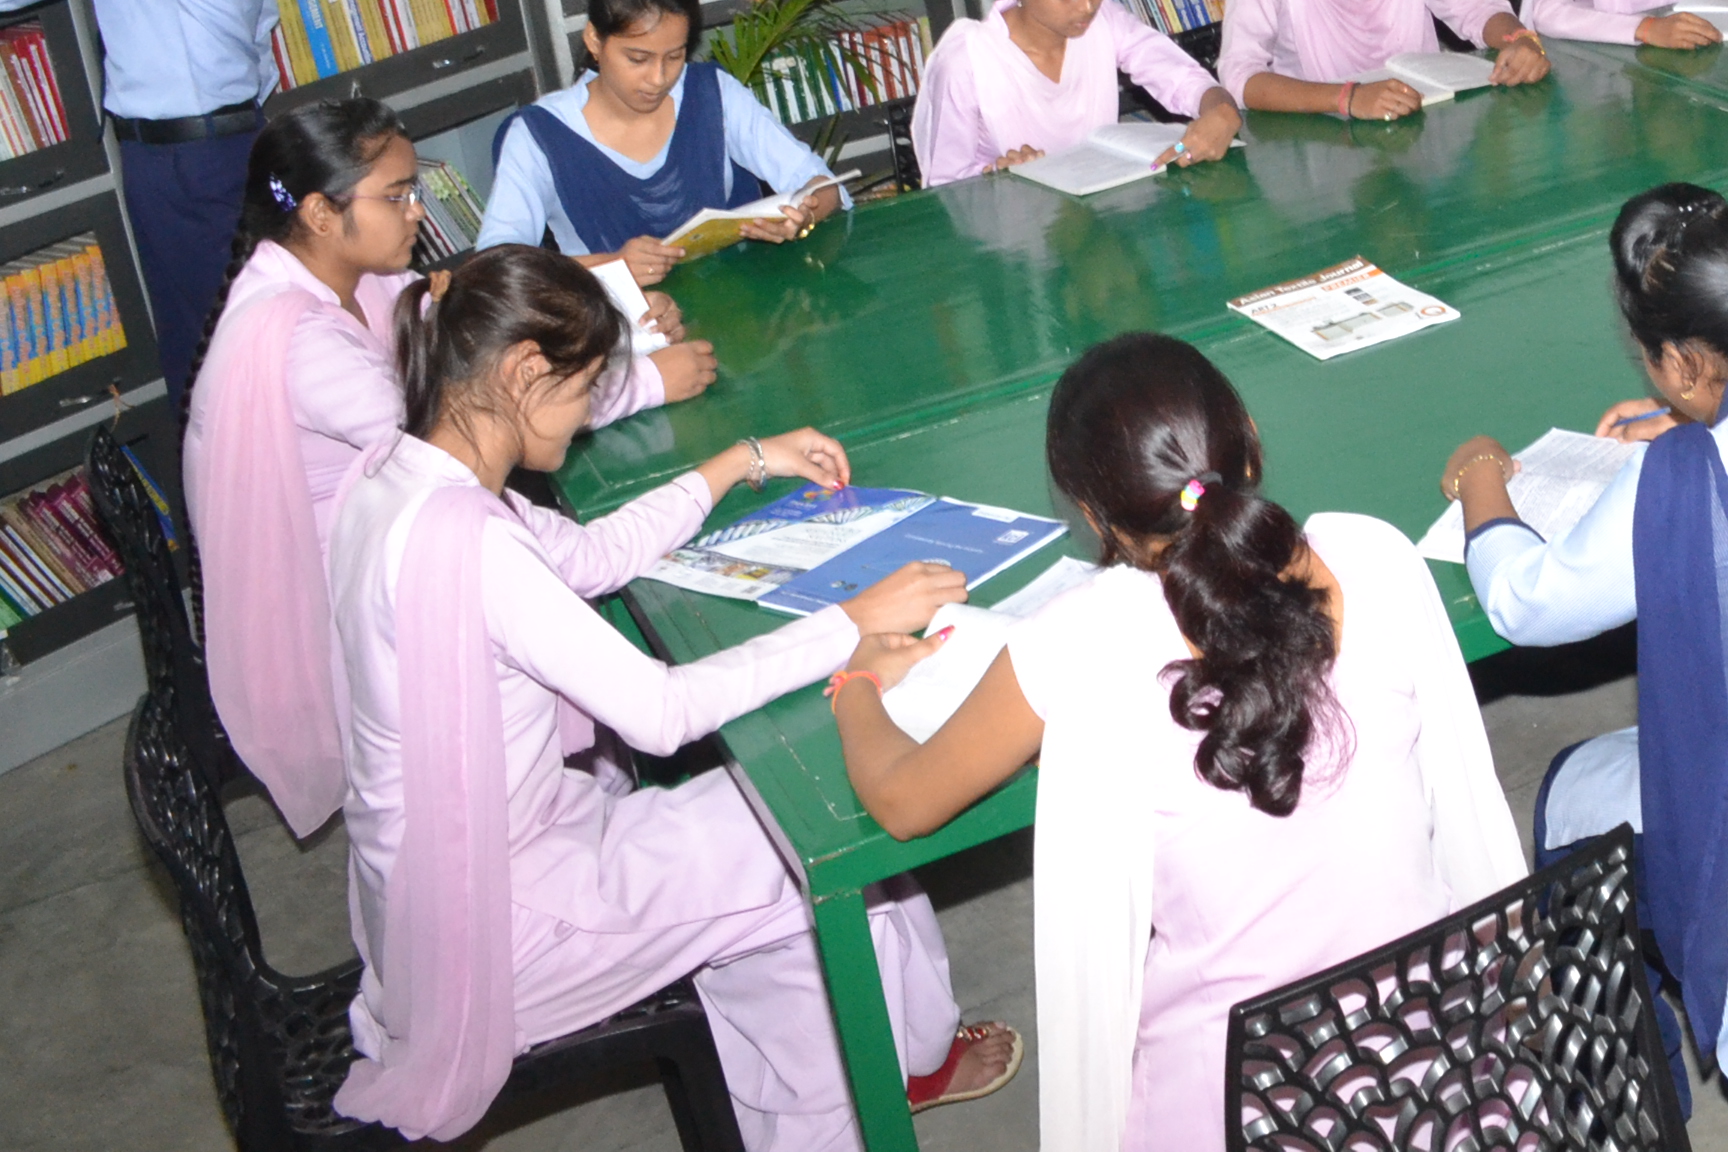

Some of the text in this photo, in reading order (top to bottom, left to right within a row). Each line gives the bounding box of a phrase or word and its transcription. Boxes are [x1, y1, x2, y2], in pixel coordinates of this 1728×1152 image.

[1240, 259, 1365, 305] Asian Textile Journal
